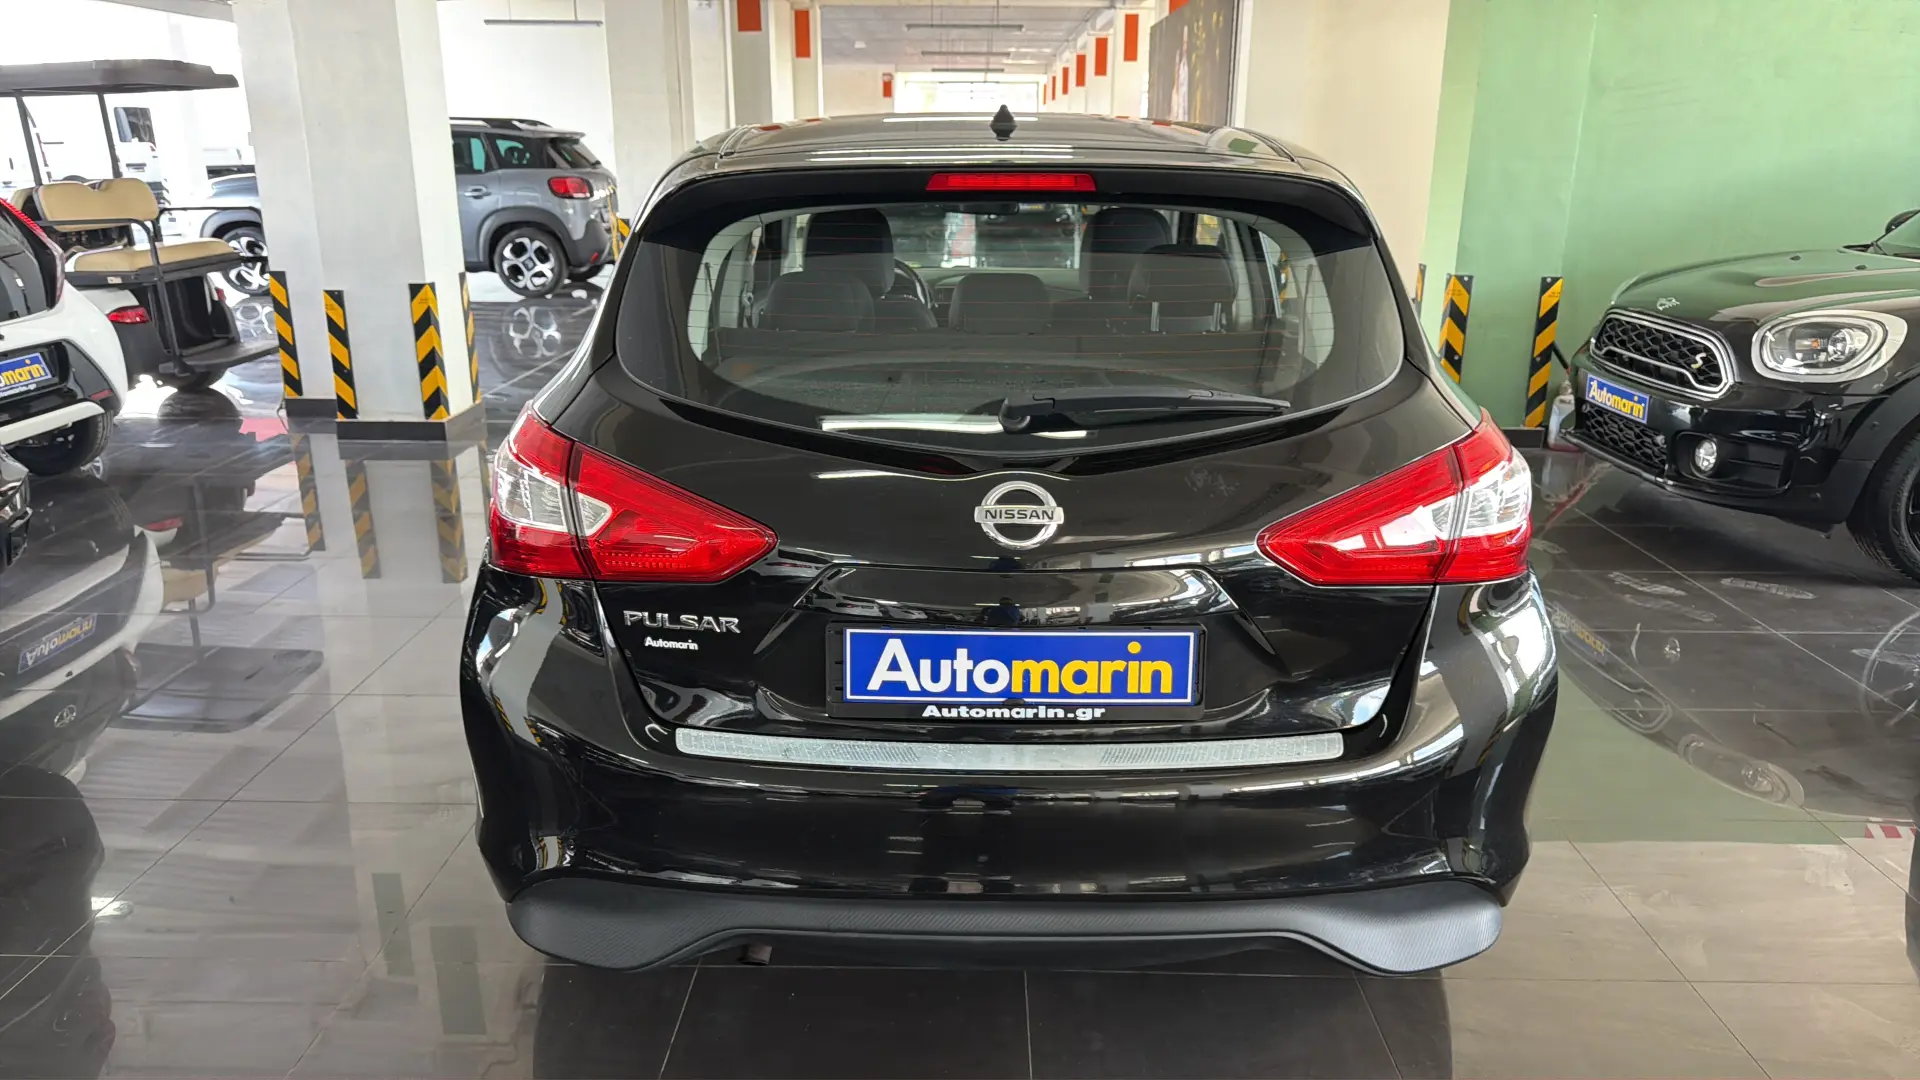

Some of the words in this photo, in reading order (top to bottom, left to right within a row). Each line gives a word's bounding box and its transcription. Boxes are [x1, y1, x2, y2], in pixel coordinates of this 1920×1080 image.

[1588, 378, 1645, 419] Automarin
[984, 509, 1054, 521] NISSAN
[623, 610, 741, 634] PULSAR
[644, 636, 699, 651] Automarin
[866, 638, 1173, 694] Automarin
[921, 704, 1106, 721] Automarin.gr
